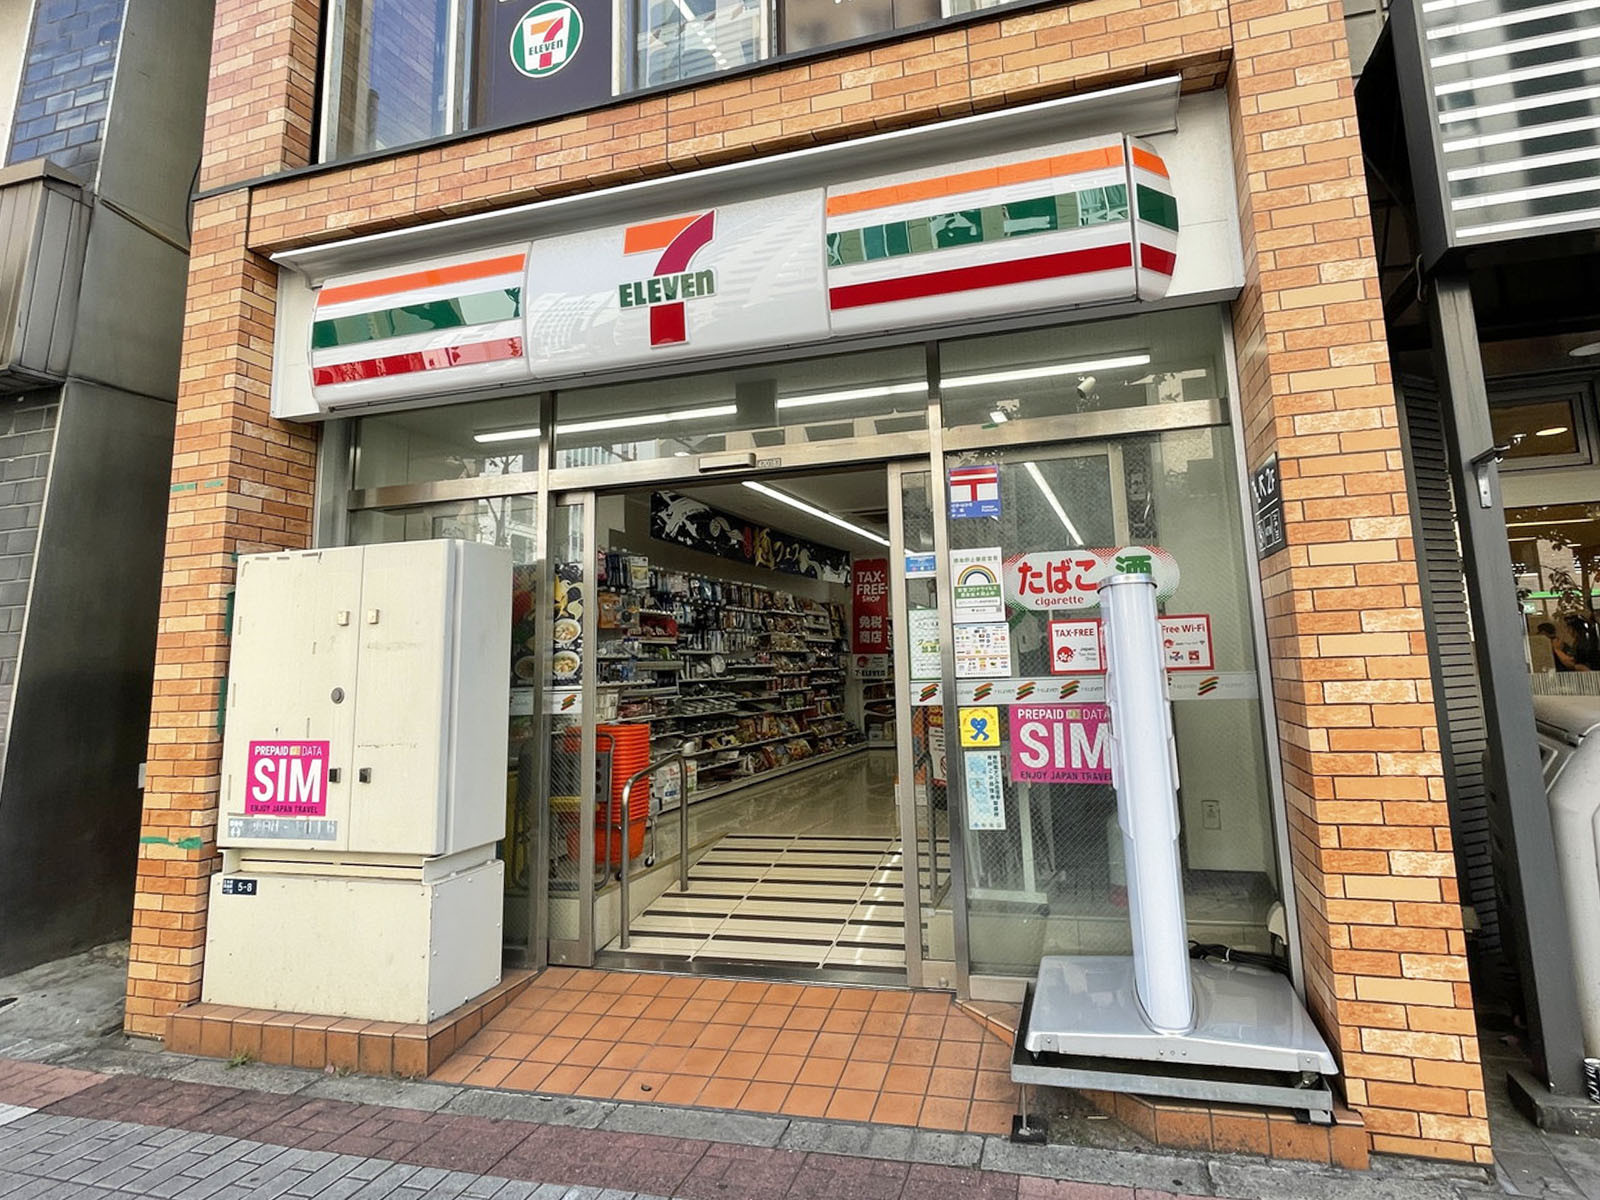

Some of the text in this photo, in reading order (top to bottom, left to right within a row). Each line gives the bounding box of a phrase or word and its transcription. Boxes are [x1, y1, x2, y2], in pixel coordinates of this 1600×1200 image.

[1018, 558, 1099, 596] たばこ
[1035, 595, 1085, 607] cigarette
[1055, 628, 1095, 637] TAX-FREE
[1181, 623, 1206, 633] Wi-Fi
[1017, 708, 1064, 720] PREPAID
[254, 745, 322, 756] PREPAID DATA
[1019, 721, 1112, 769] SIM
[252, 757, 322, 803] SIM
[1020, 771, 1047, 780] ENJOY
[1050, 771, 1078, 780] JAPAN
[272, 805, 292, 813] JAPAN
[295, 805, 318, 813] TRAVEL
